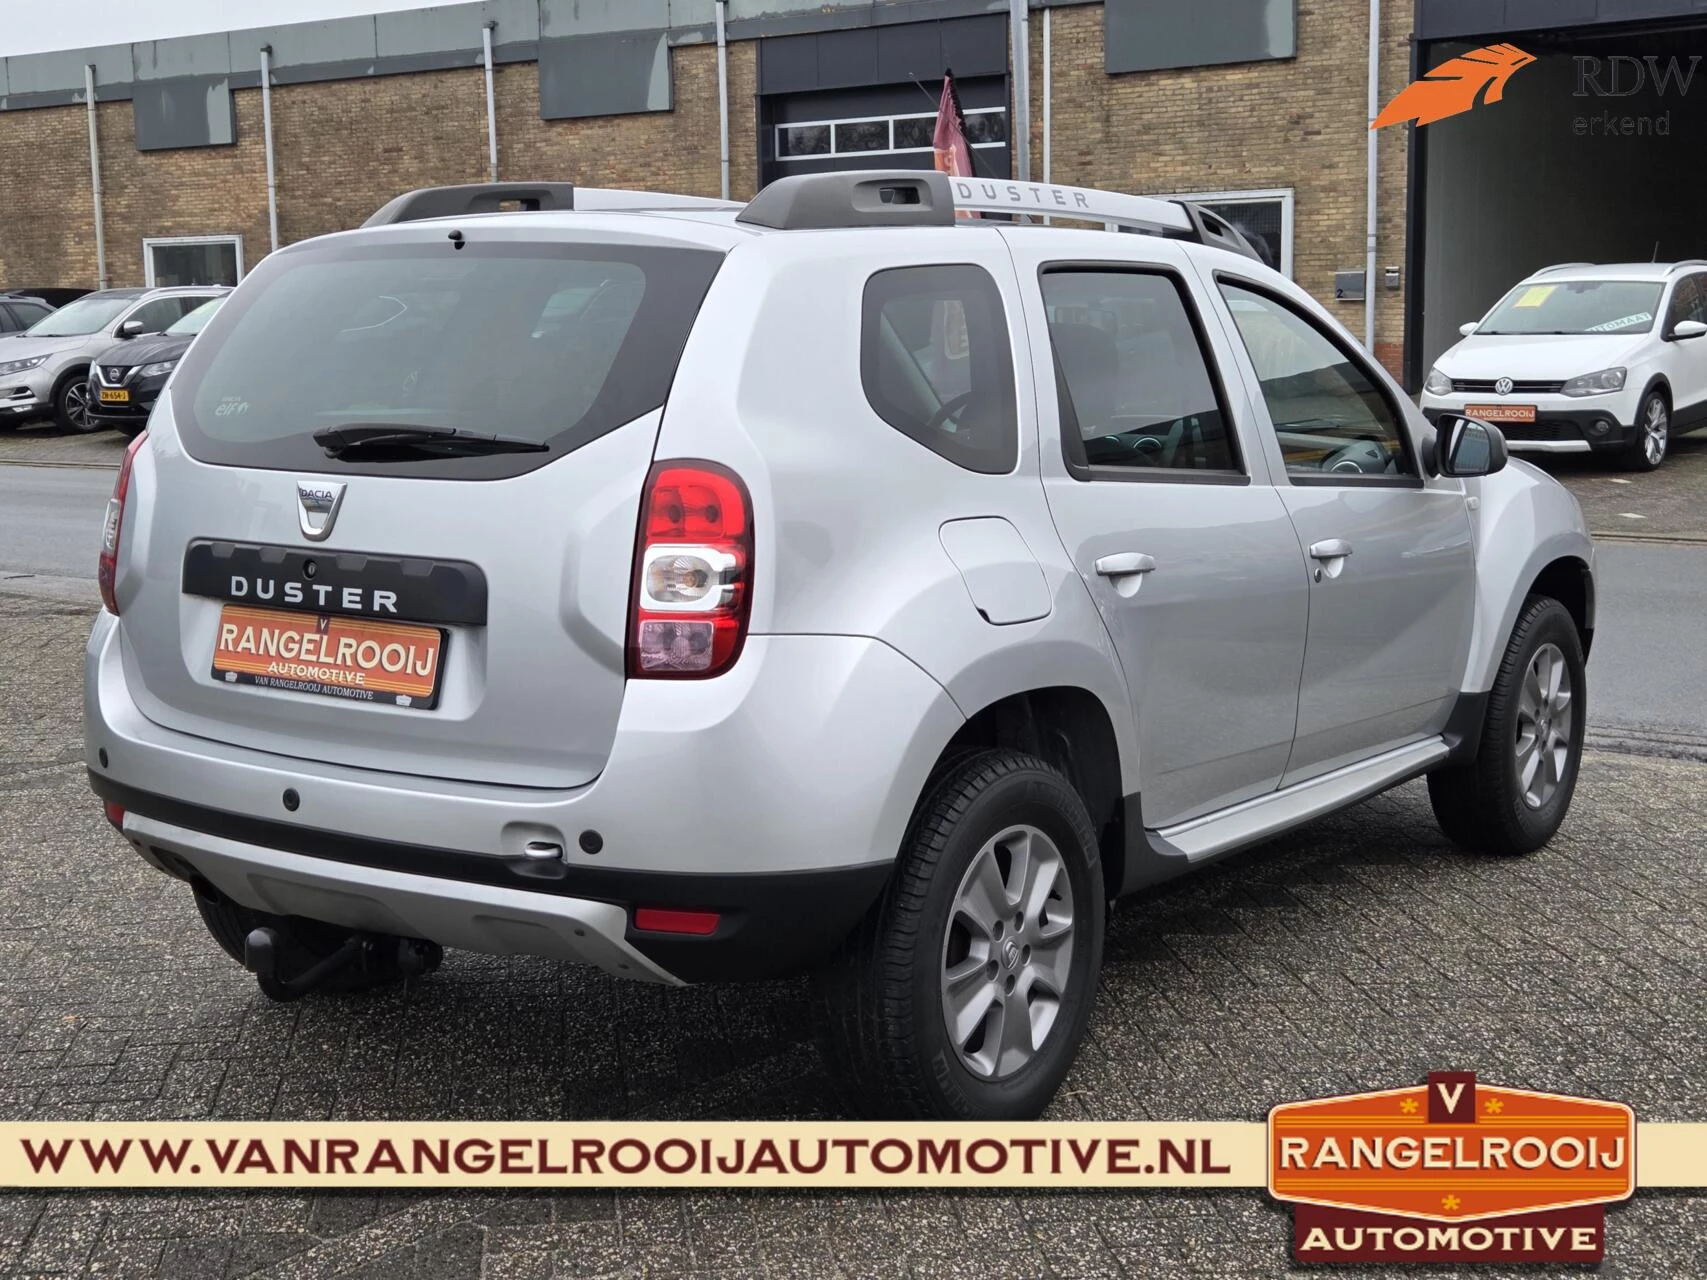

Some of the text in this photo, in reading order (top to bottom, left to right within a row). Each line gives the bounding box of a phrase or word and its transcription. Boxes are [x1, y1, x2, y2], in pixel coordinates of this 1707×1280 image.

[956, 182, 1090, 209] DUSTER
[1336, 288, 1344, 298] 2
[1465, 408, 1535, 418] RANGELROOIJ
[301, 489, 332, 499] DACIA
[231, 575, 398, 613] DUSTER
[320, 619, 327, 630] V
[219, 623, 434, 676] RANGELROOIJ
[267, 661, 366, 685] AUTOMOTIVE
[255, 675, 374, 700] VAN RANGELROOIJ AUTOMOTIVE
